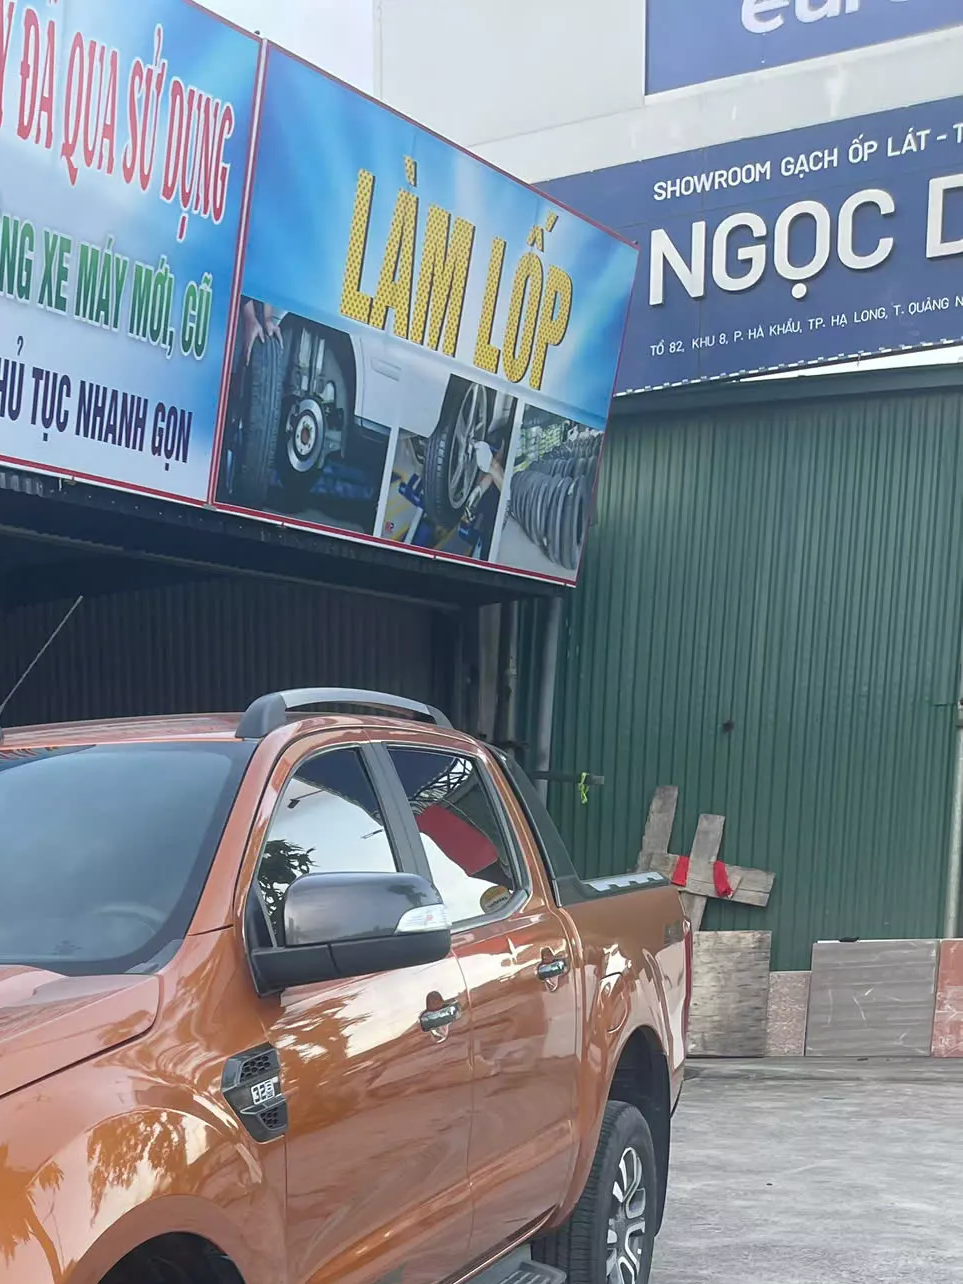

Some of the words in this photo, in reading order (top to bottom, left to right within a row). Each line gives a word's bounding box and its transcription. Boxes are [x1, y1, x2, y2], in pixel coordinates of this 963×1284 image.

[61, 32, 118, 186] QUA
[123, 28, 166, 190] SỬ
[161, 79, 233, 240] DỤNG
[653, 161, 771, 201] SHOWROOM
[781, 148, 838, 179] GẠCH
[849, 134, 877, 163] ỐP
[887, 127, 931, 157] LÁT
[38, 229, 72, 312] XE
[74, 236, 129, 329] MÁY
[129, 256, 174, 357] MỚI,
[181, 274, 213, 358] CŨ
[340, 156, 476, 357] LÀM
[473, 210, 573, 391] LỐP
[649, 188, 895, 306] NGỌC
[650, 339, 664, 356] TỔ
[669, 341, 685, 354] 82,
[692, 335, 715, 349] KHU
[719, 333, 728, 345] 8,
[734, 330, 744, 342] P.
[748, 325, 764, 340] HÀ
[769, 318, 802, 337] KHẨU,
[808, 317, 826, 331] TP.
[831, 313, 848, 328] HẠ
[854, 307, 888, 323] LONG,
[893, 304, 905, 316] T.
[908, 296, 949, 315] QUẢNG
[31, 366, 71, 442] TỤC
[75, 379, 148, 452] NHANH
[151, 402, 193, 471] GỌN
